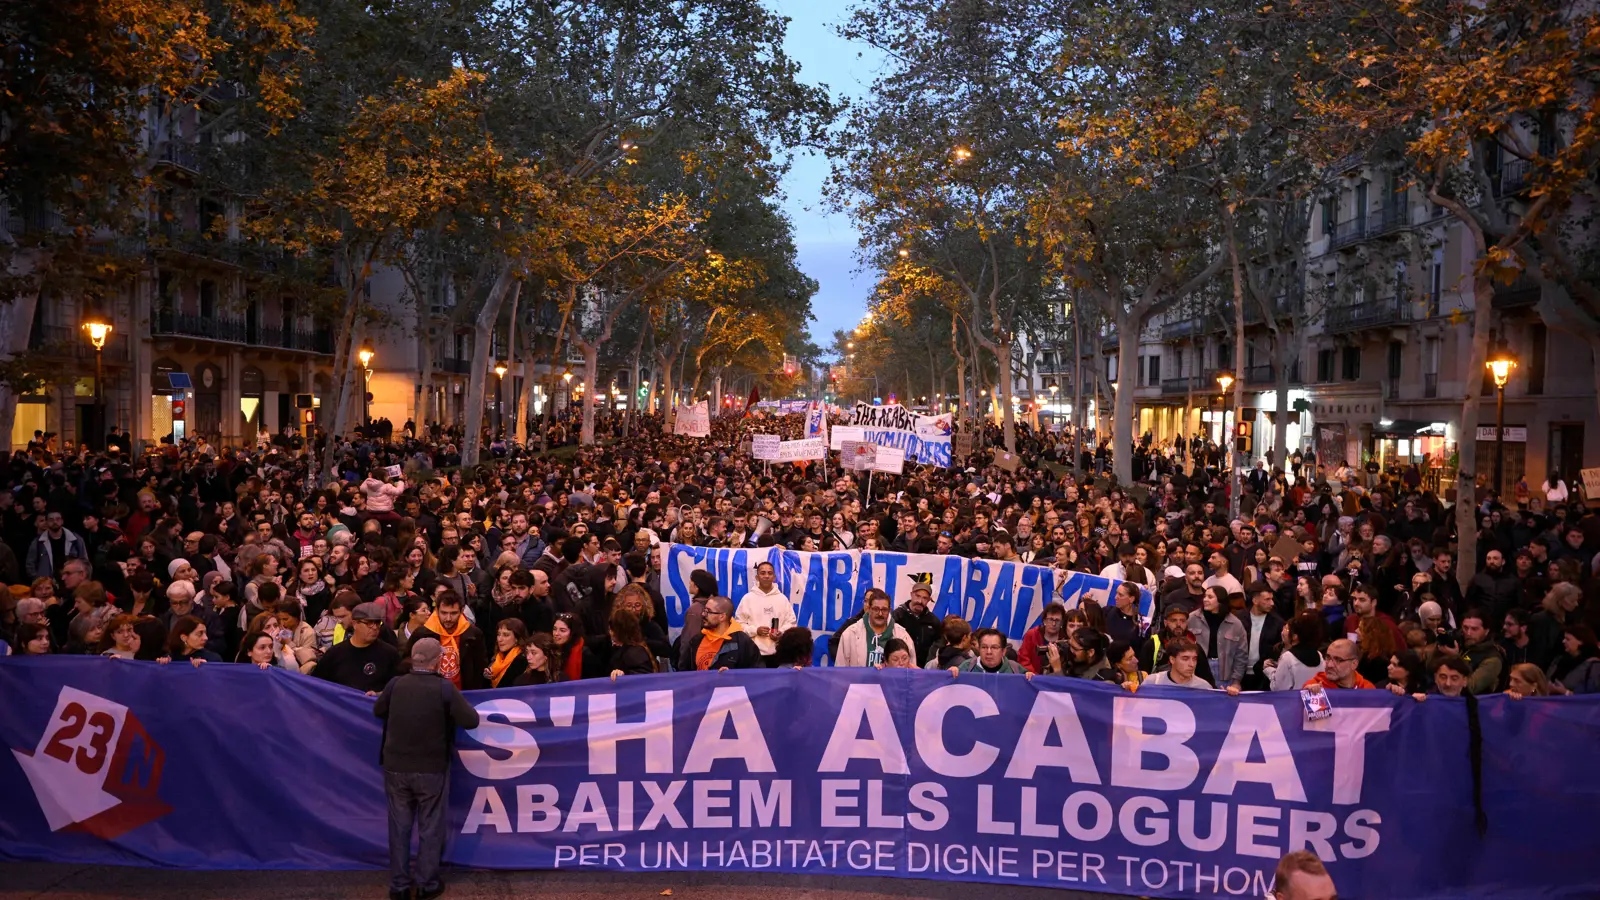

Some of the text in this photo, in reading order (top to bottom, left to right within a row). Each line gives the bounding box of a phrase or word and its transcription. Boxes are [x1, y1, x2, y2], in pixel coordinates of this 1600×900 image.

[878, 405, 920, 433] ACABAT
[1314, 404, 1376, 413] FARMACIA
[666, 544, 748, 628] S'HA
[43, 702, 116, 774] 23
[457, 683, 1394, 805] S'HA ACABAT
[461, 779, 1381, 863] ABAIXEM ELS LLOGUERS
[554, 839, 1276, 897] PER UN HABITATGE DIGNE PER TOTHOM
